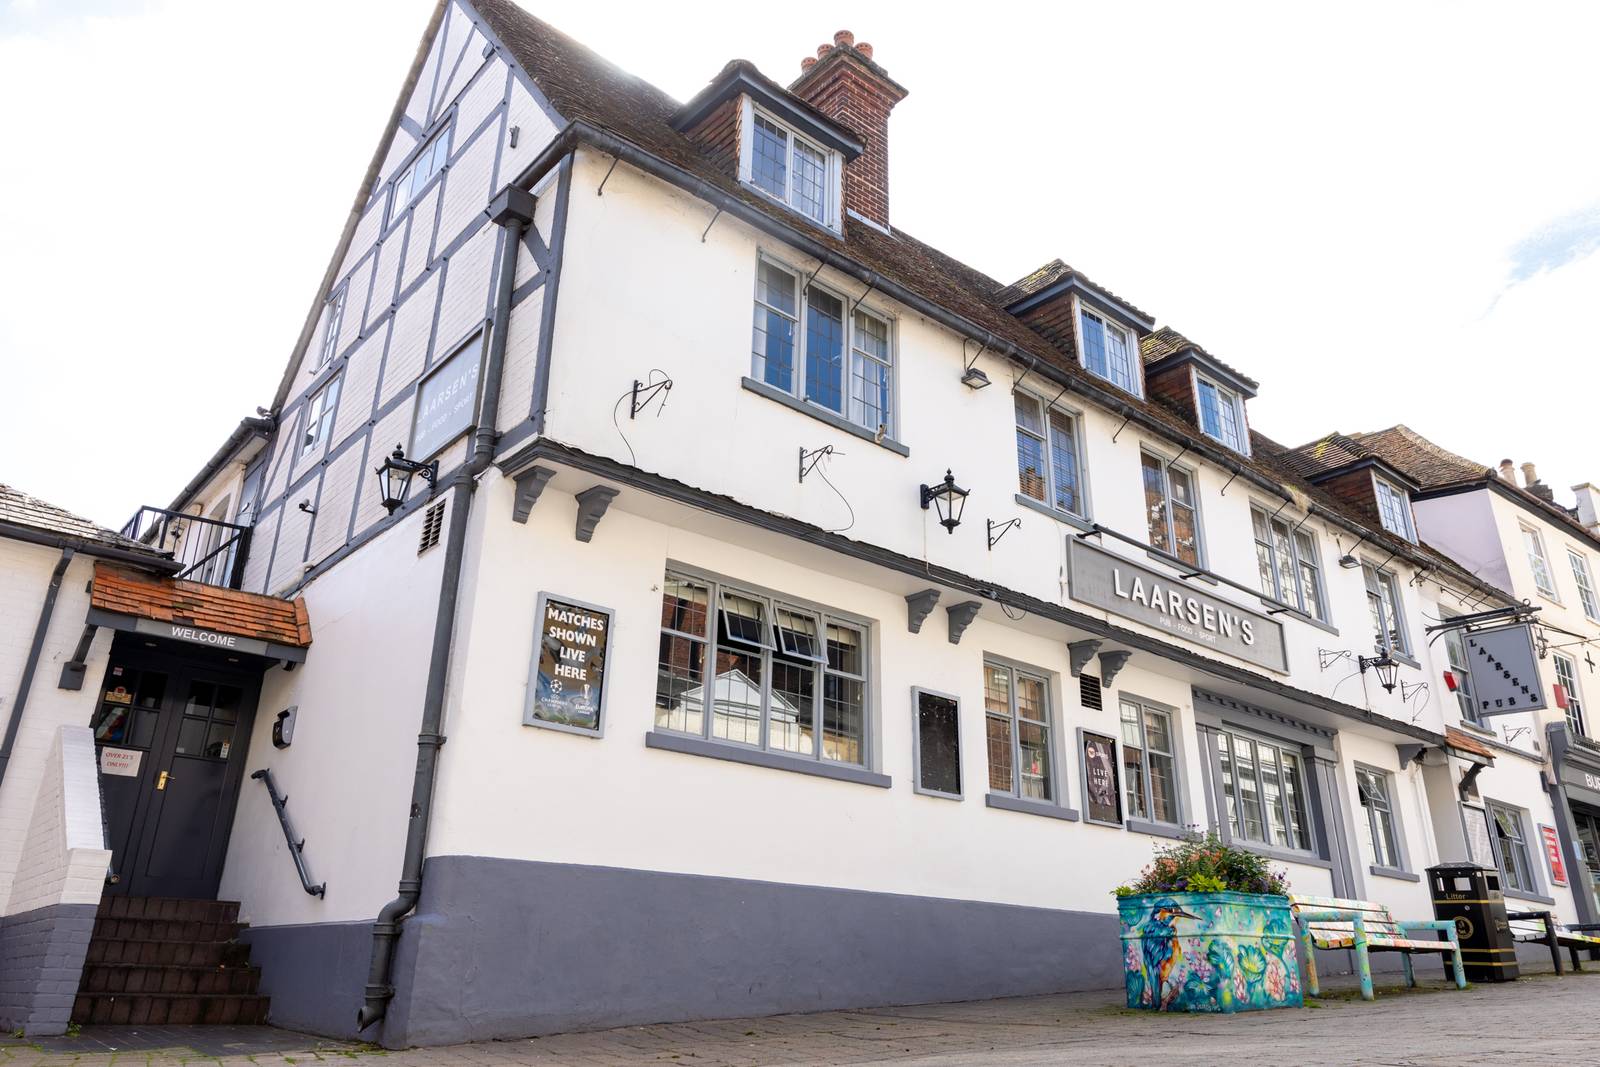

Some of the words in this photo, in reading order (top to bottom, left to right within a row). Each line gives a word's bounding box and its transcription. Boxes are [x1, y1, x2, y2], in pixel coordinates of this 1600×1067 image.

[1113, 568, 1255, 645] LAARSEN'S
[548, 607, 604, 631] MATCHES
[171, 626, 237, 647] WELCOME
[549, 626, 597, 647] SHOWN
[560, 646, 586, 662] LIVE
[554, 663, 587, 681] HERE
[1469, 639, 1538, 703] LAARSENS
[1482, 696, 1516, 710] PUB
[1092, 767, 1108, 777] LIVE
[1093, 778, 1109, 787] HERE
